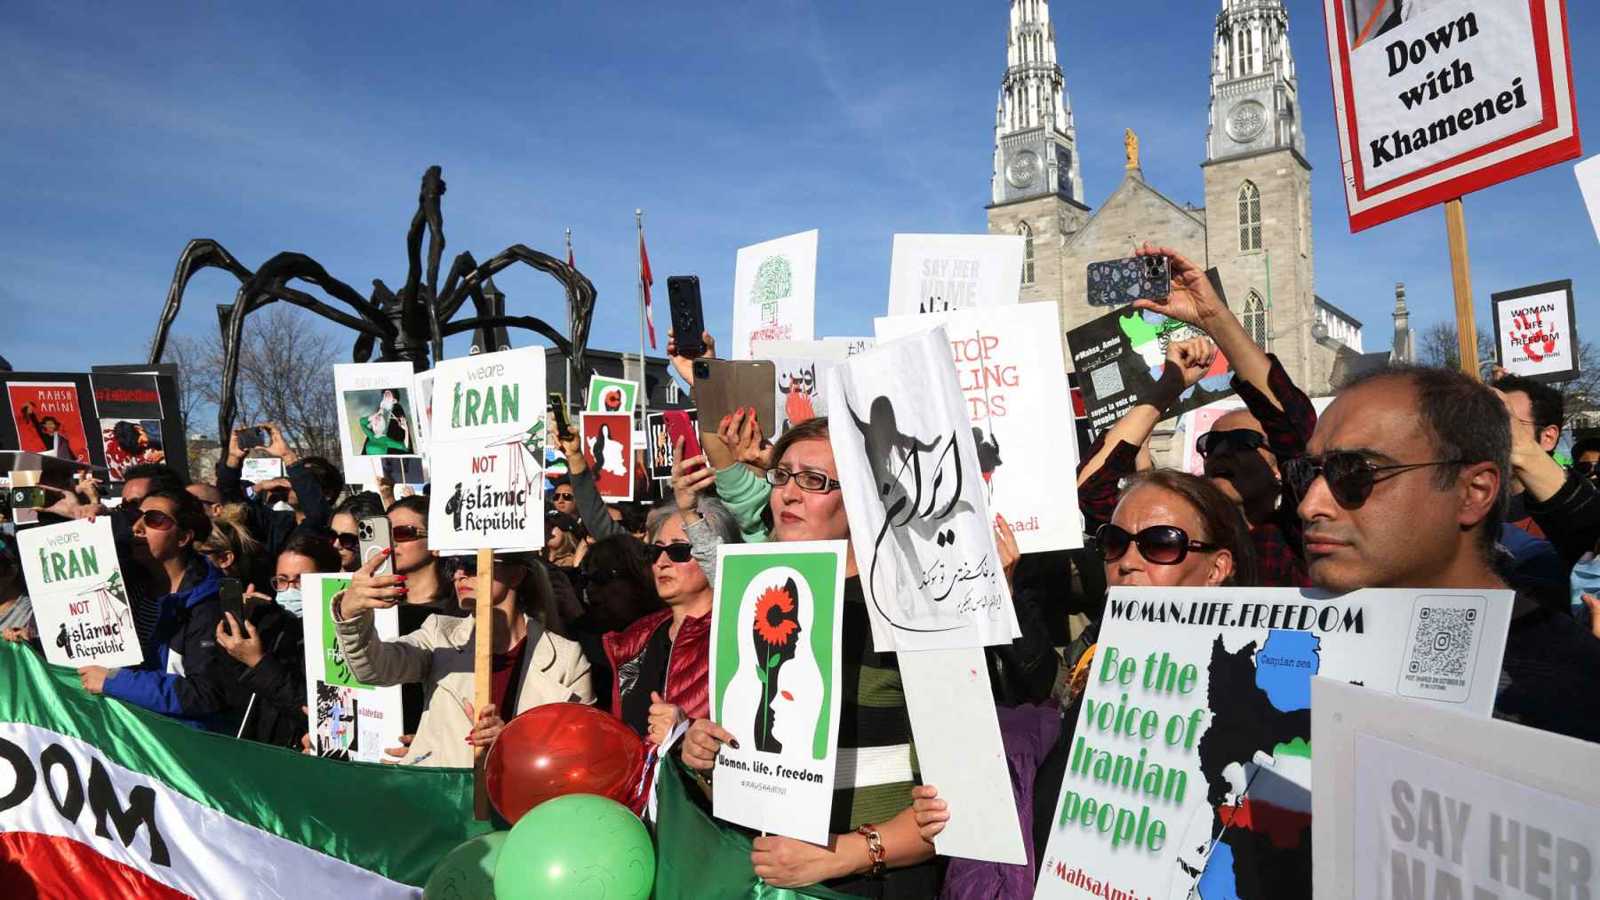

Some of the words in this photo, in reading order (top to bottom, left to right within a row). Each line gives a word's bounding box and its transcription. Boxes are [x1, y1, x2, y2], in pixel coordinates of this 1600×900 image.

[1385, 12, 1479, 77] Down
[1398, 58, 1474, 110] with
[1369, 77, 1527, 168] Khamenei
[1511, 304, 1555, 318] WOMAN
[951, 336, 999, 362] TOP
[1511, 332, 1559, 347] FREEDOM
[40, 402, 74, 412] AMINI
[451, 382, 519, 428] IRAN
[968, 395, 1006, 421] DS
[472, 455, 498, 474] NOT
[39, 545, 99, 584] IRAN
[69, 600, 90, 616] NOT
[1099, 646, 1137, 686] Be
[1142, 652, 1198, 694] the
[1087, 693, 1159, 740] voice
[1165, 708, 1206, 751] of
[719, 754, 750, 772] Woman.
[753, 761, 772, 776] Life.
[776, 765, 823, 784] Freedom
[1070, 736, 1188, 803] Iranian
[1059, 790, 1167, 851] people
[1391, 779, 1473, 866] SAY
[1489, 812, 1592, 900] HER
